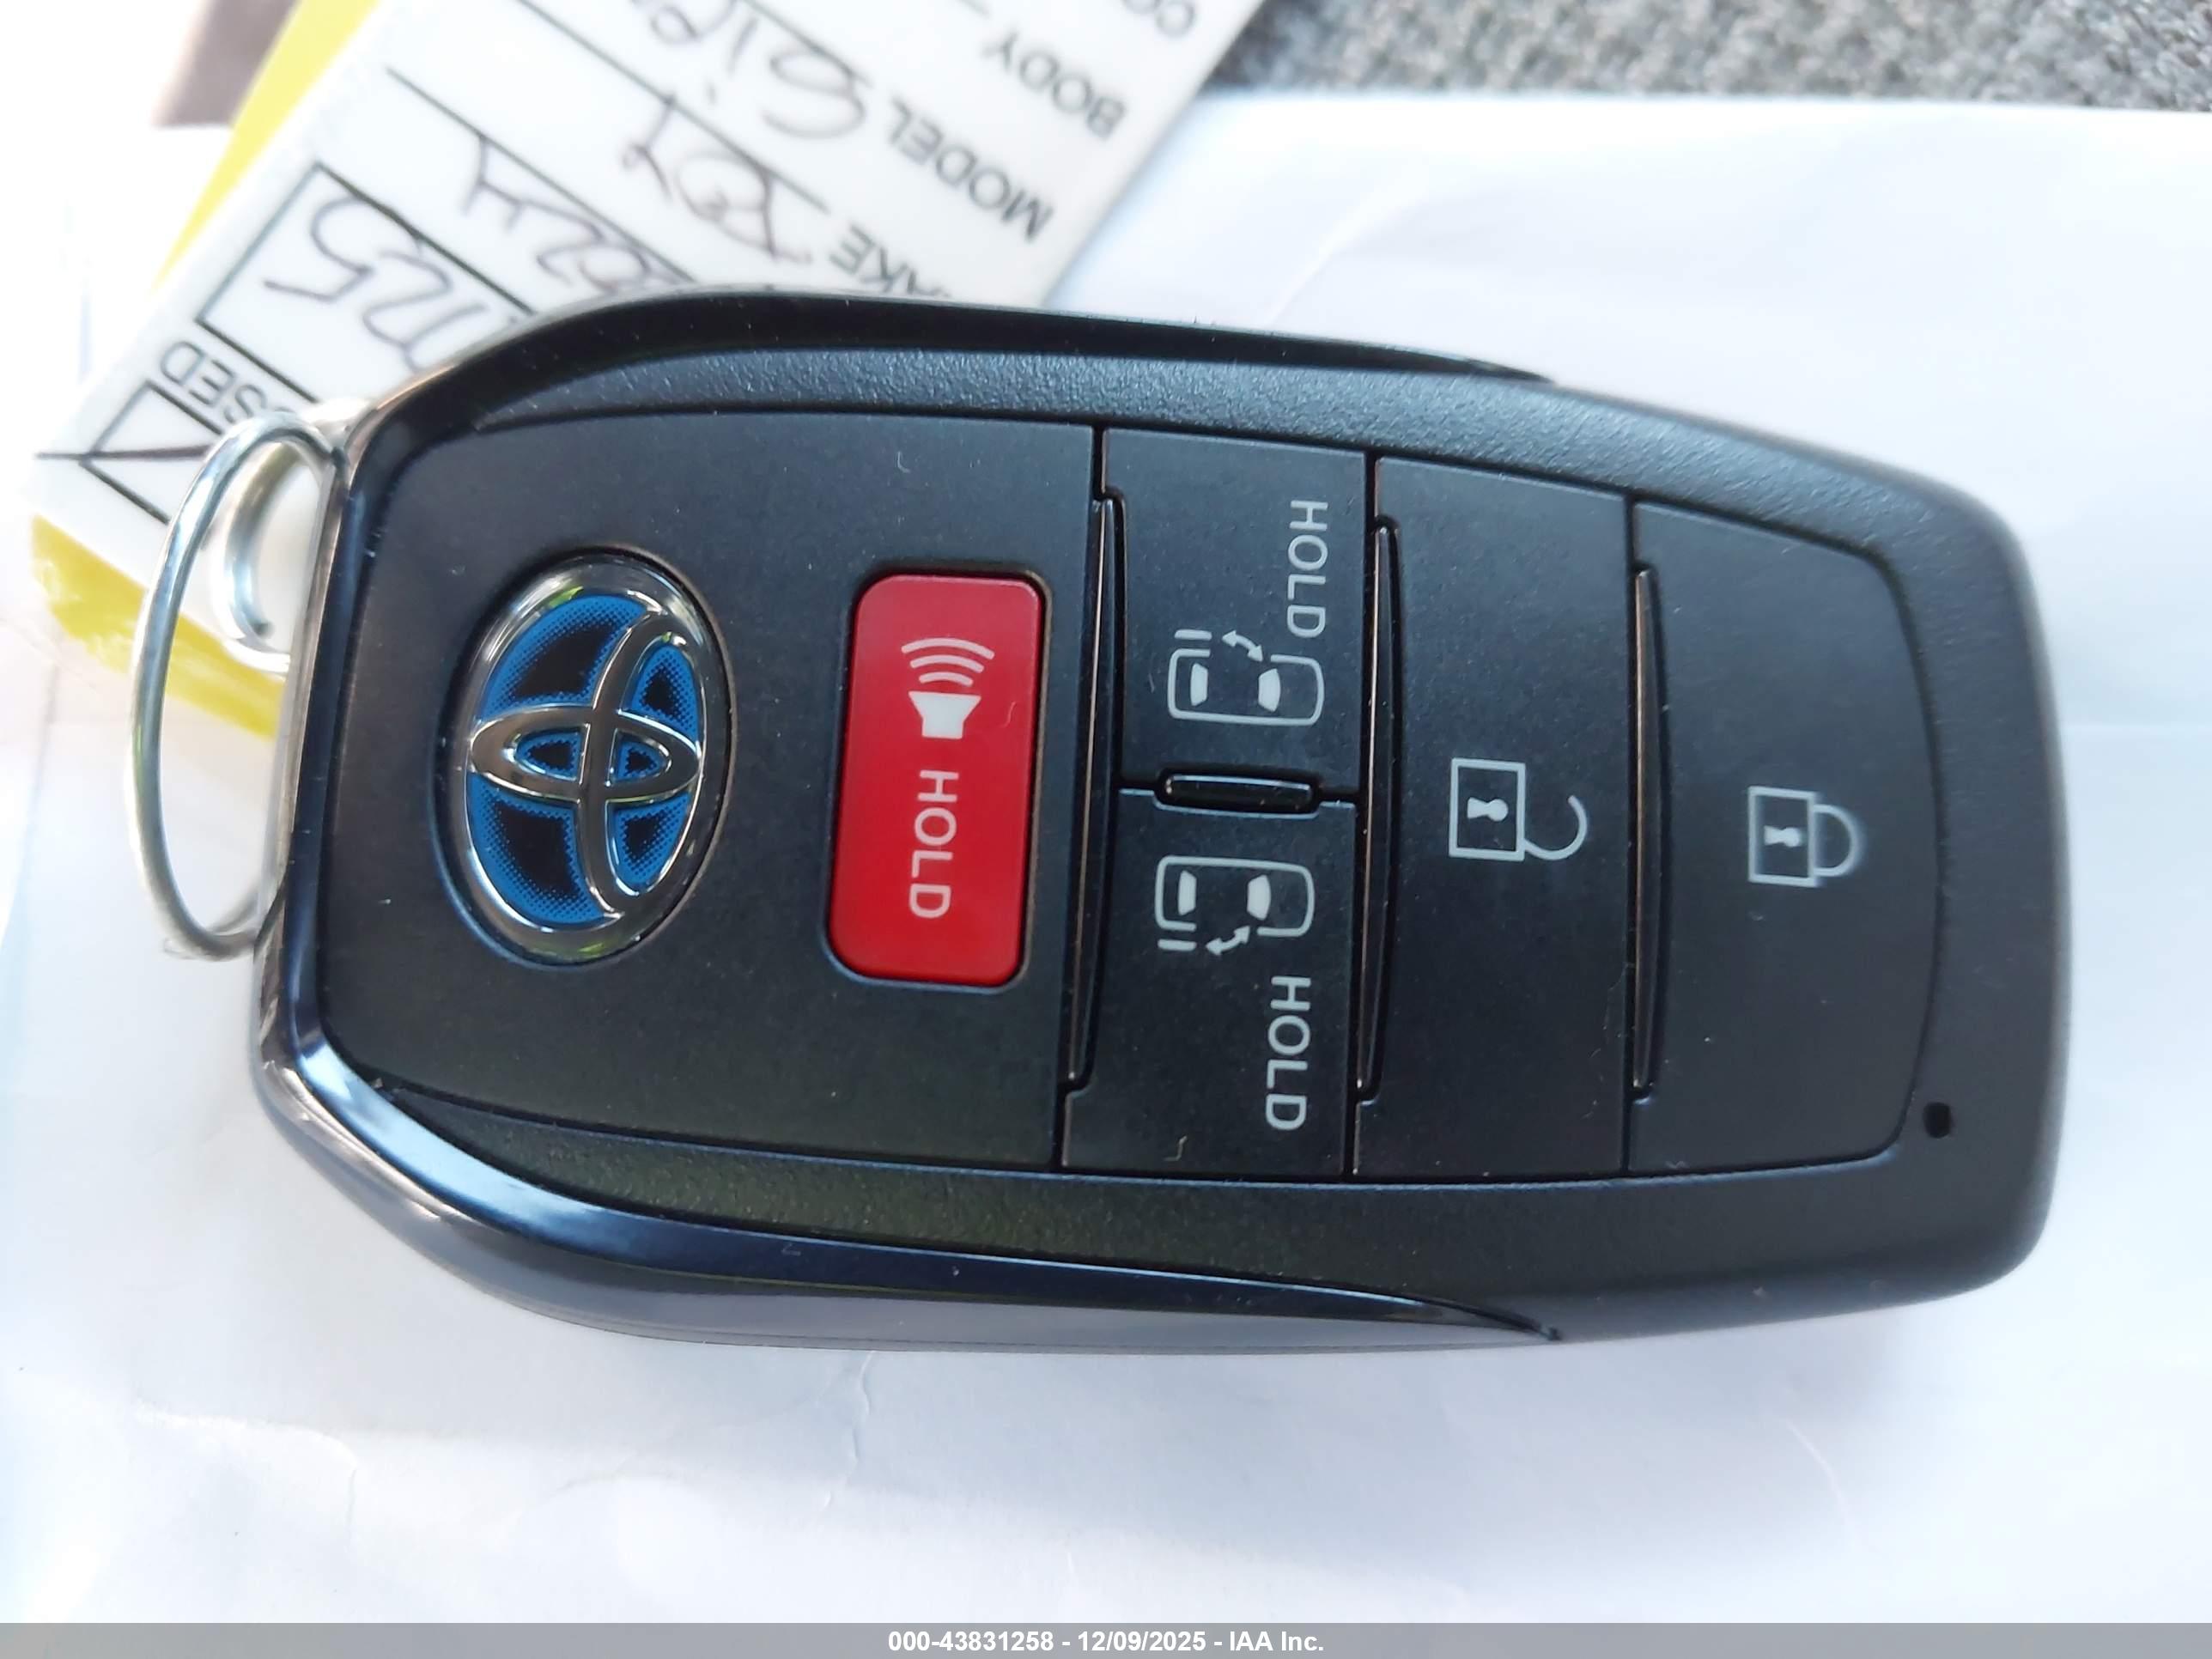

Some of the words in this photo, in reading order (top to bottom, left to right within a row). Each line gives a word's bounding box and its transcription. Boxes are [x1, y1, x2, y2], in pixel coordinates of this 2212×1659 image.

[981, 27, 1127, 140] BODY
[459, 132, 683, 295] 024
[888, 94, 1054, 244] MODEL
[829, 222, 952, 297] AKE
[160, 341, 296, 424] SED
[1286, 500, 1329, 638] HOLD
[908, 769, 960, 920] HOLD
[1266, 976, 1312, 1131] HOLD
